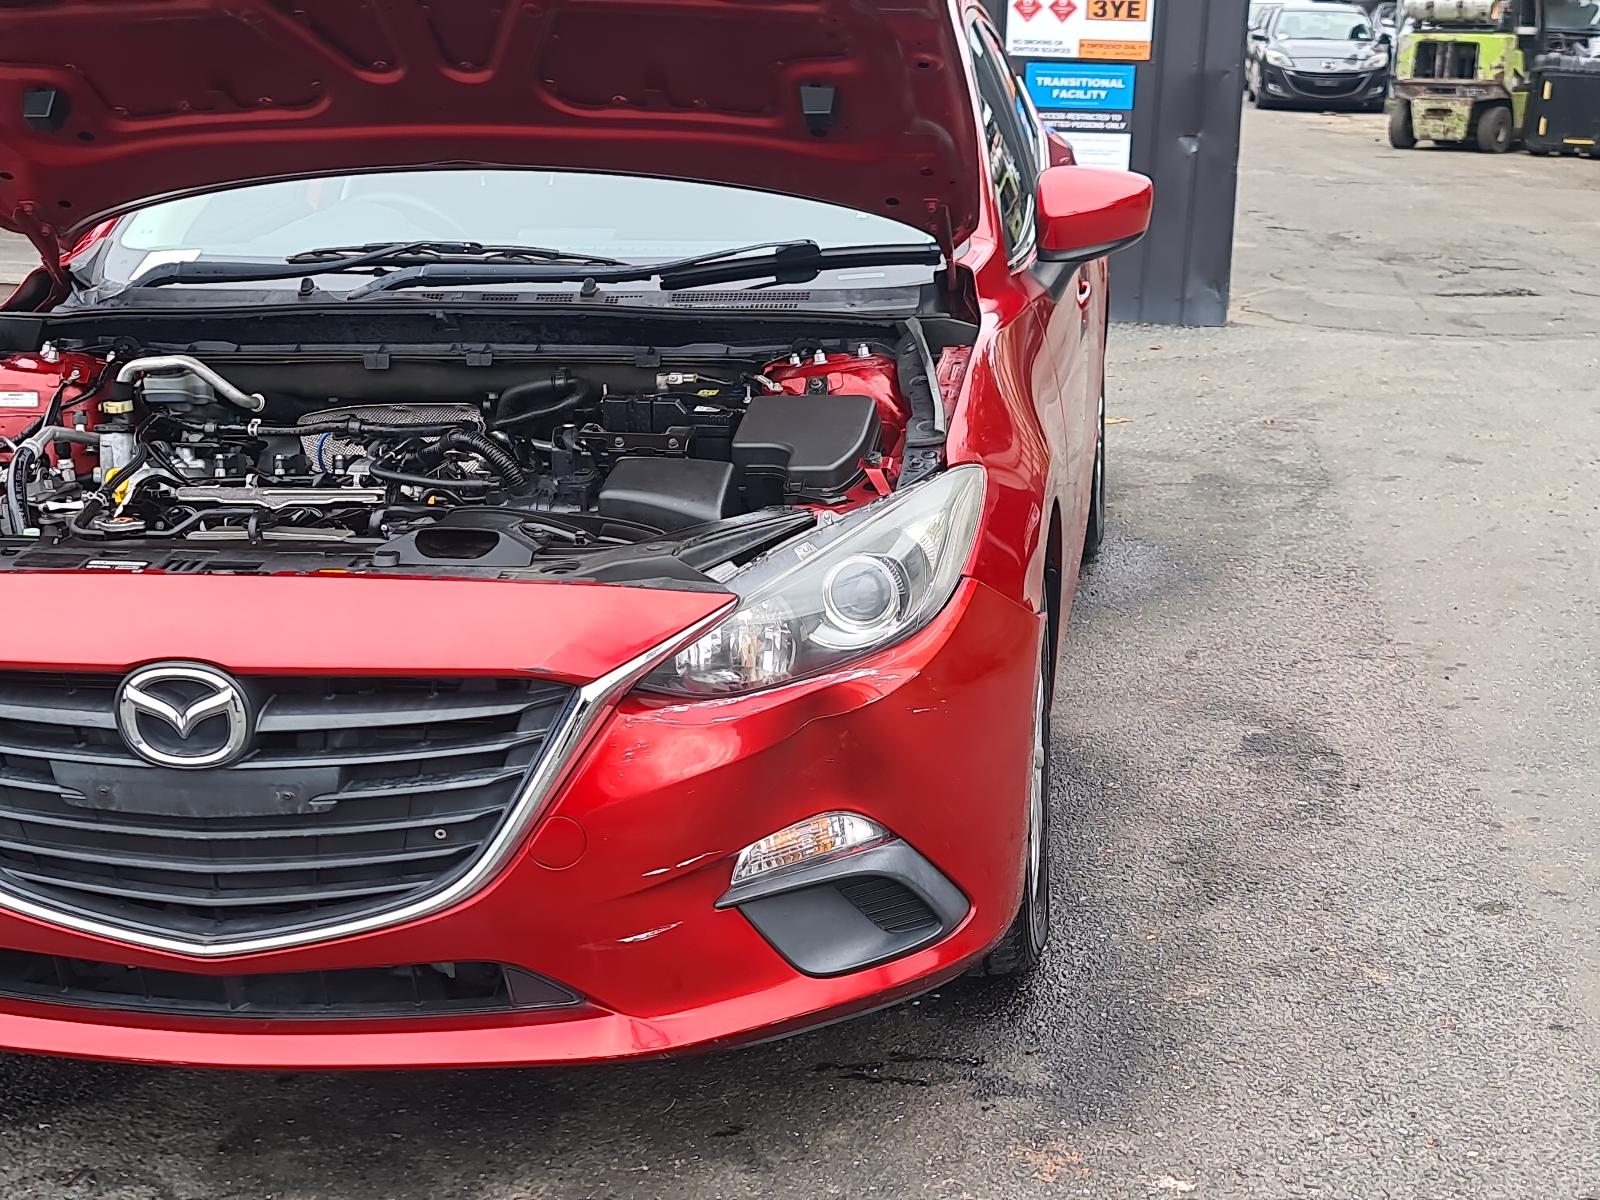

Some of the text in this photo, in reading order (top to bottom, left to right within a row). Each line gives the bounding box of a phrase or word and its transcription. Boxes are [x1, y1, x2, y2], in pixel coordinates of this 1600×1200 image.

[1093, 0, 1140, 18] 3YE
[1037, 77, 1126, 88] TRANSITIONAL
[1053, 89, 1108, 99] FACILITY
